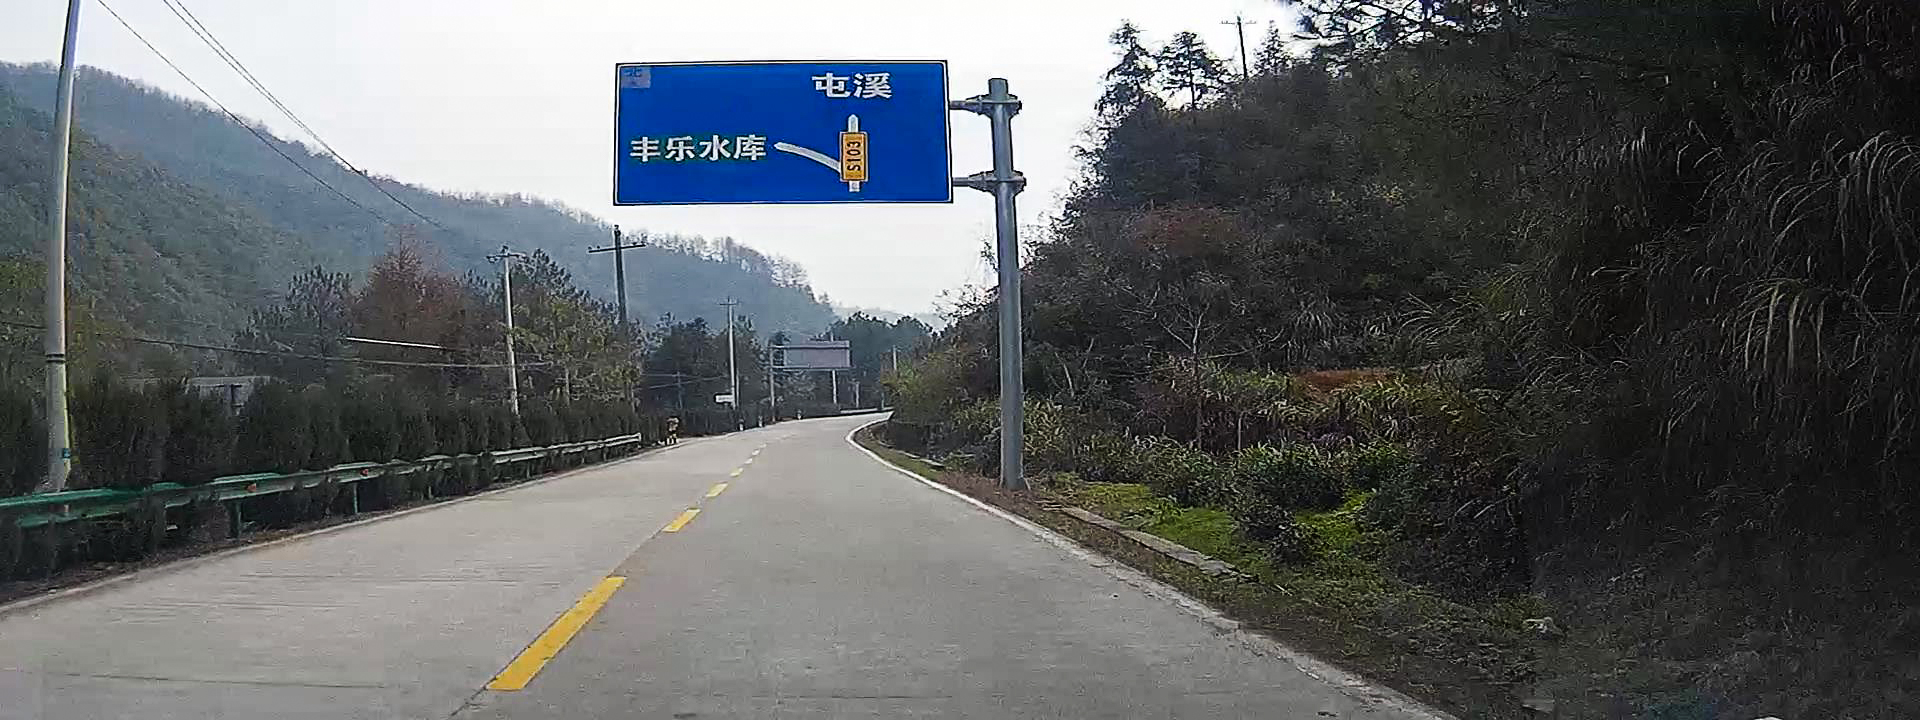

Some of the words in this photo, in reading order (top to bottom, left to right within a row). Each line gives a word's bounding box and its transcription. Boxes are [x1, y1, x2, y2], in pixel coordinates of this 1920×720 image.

[811, 72, 892, 98] 屯溪
[629, 134, 767, 162] 丰乐水库
[846, 141, 861, 171] S103
